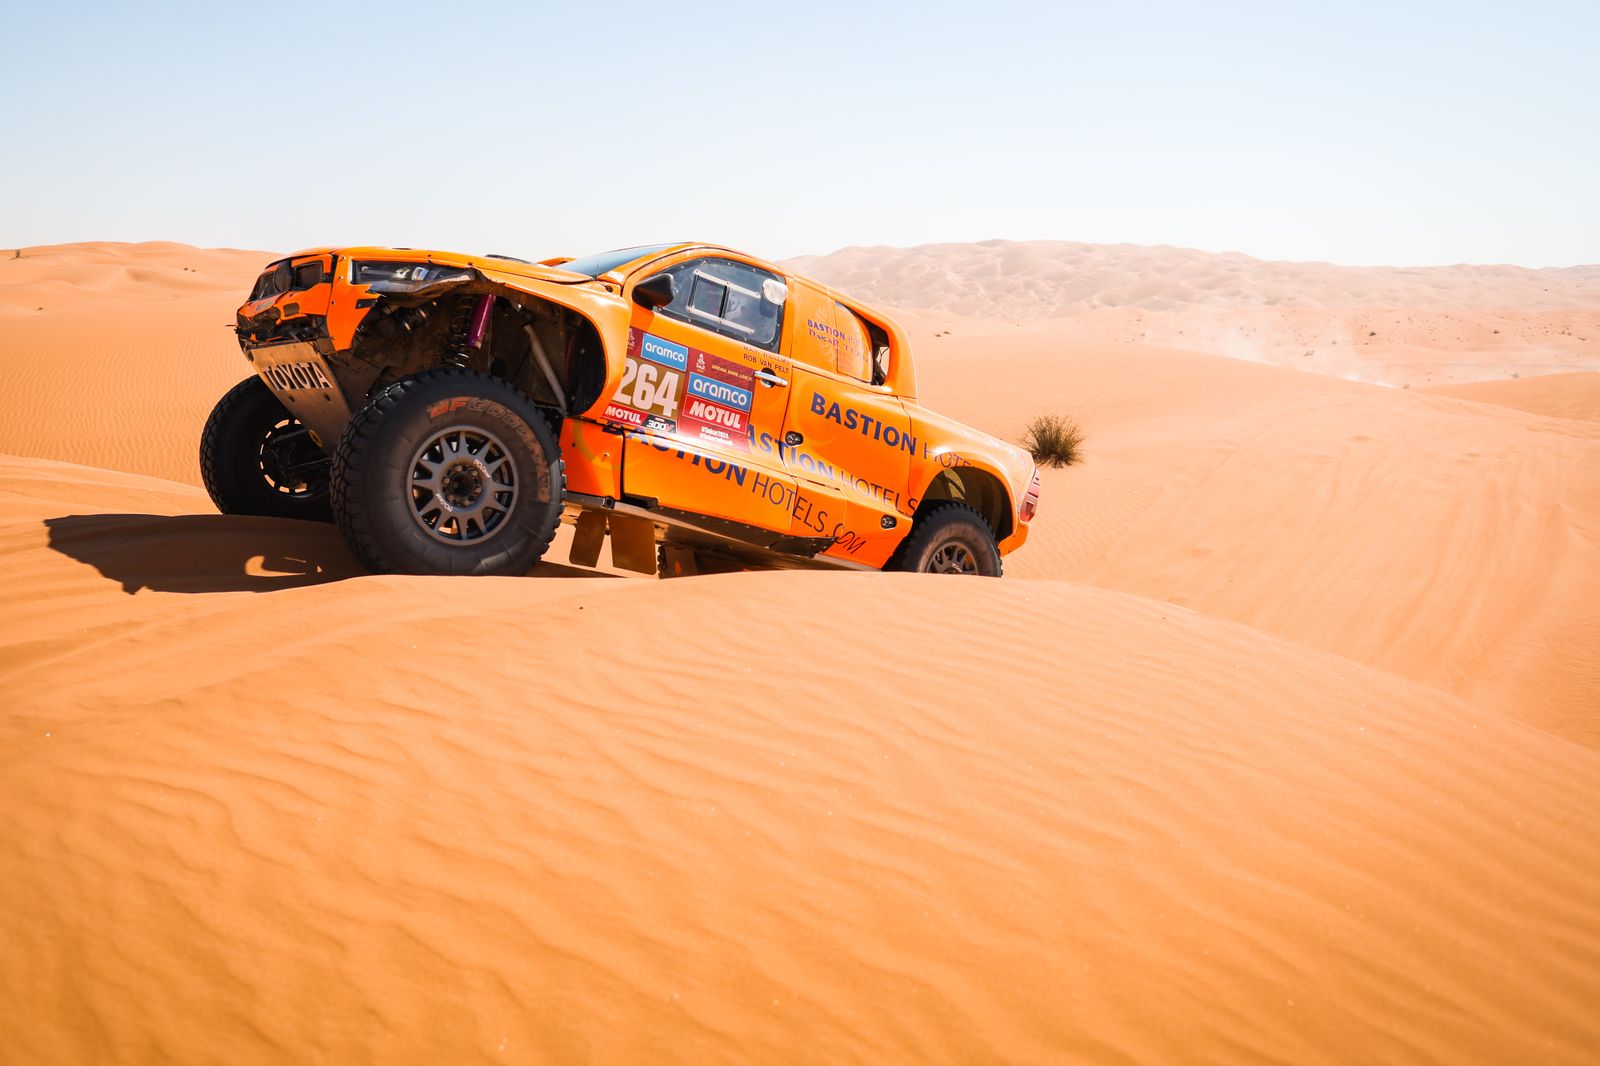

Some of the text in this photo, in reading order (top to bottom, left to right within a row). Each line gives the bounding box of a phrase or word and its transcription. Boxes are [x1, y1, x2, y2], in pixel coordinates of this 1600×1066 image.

[807, 319, 846, 340] BASTION
[645, 341, 685, 363] aramco
[743, 353, 757, 363] ROB
[760, 358, 773, 369] VAN
[774, 363, 790, 374] PELT
[261, 361, 333, 392] TOYOTA
[612, 357, 679, 417] 264
[693, 378, 747, 406] aramco
[604, 405, 642, 424] MOTUL
[646, 418, 676, 433] 300V
[688, 400, 742, 430] MOTUL
[810, 391, 918, 457] BASTION
[747, 424, 919, 518] ASTION HOTELS
[751, 471, 867, 555] HOTELS.COM
